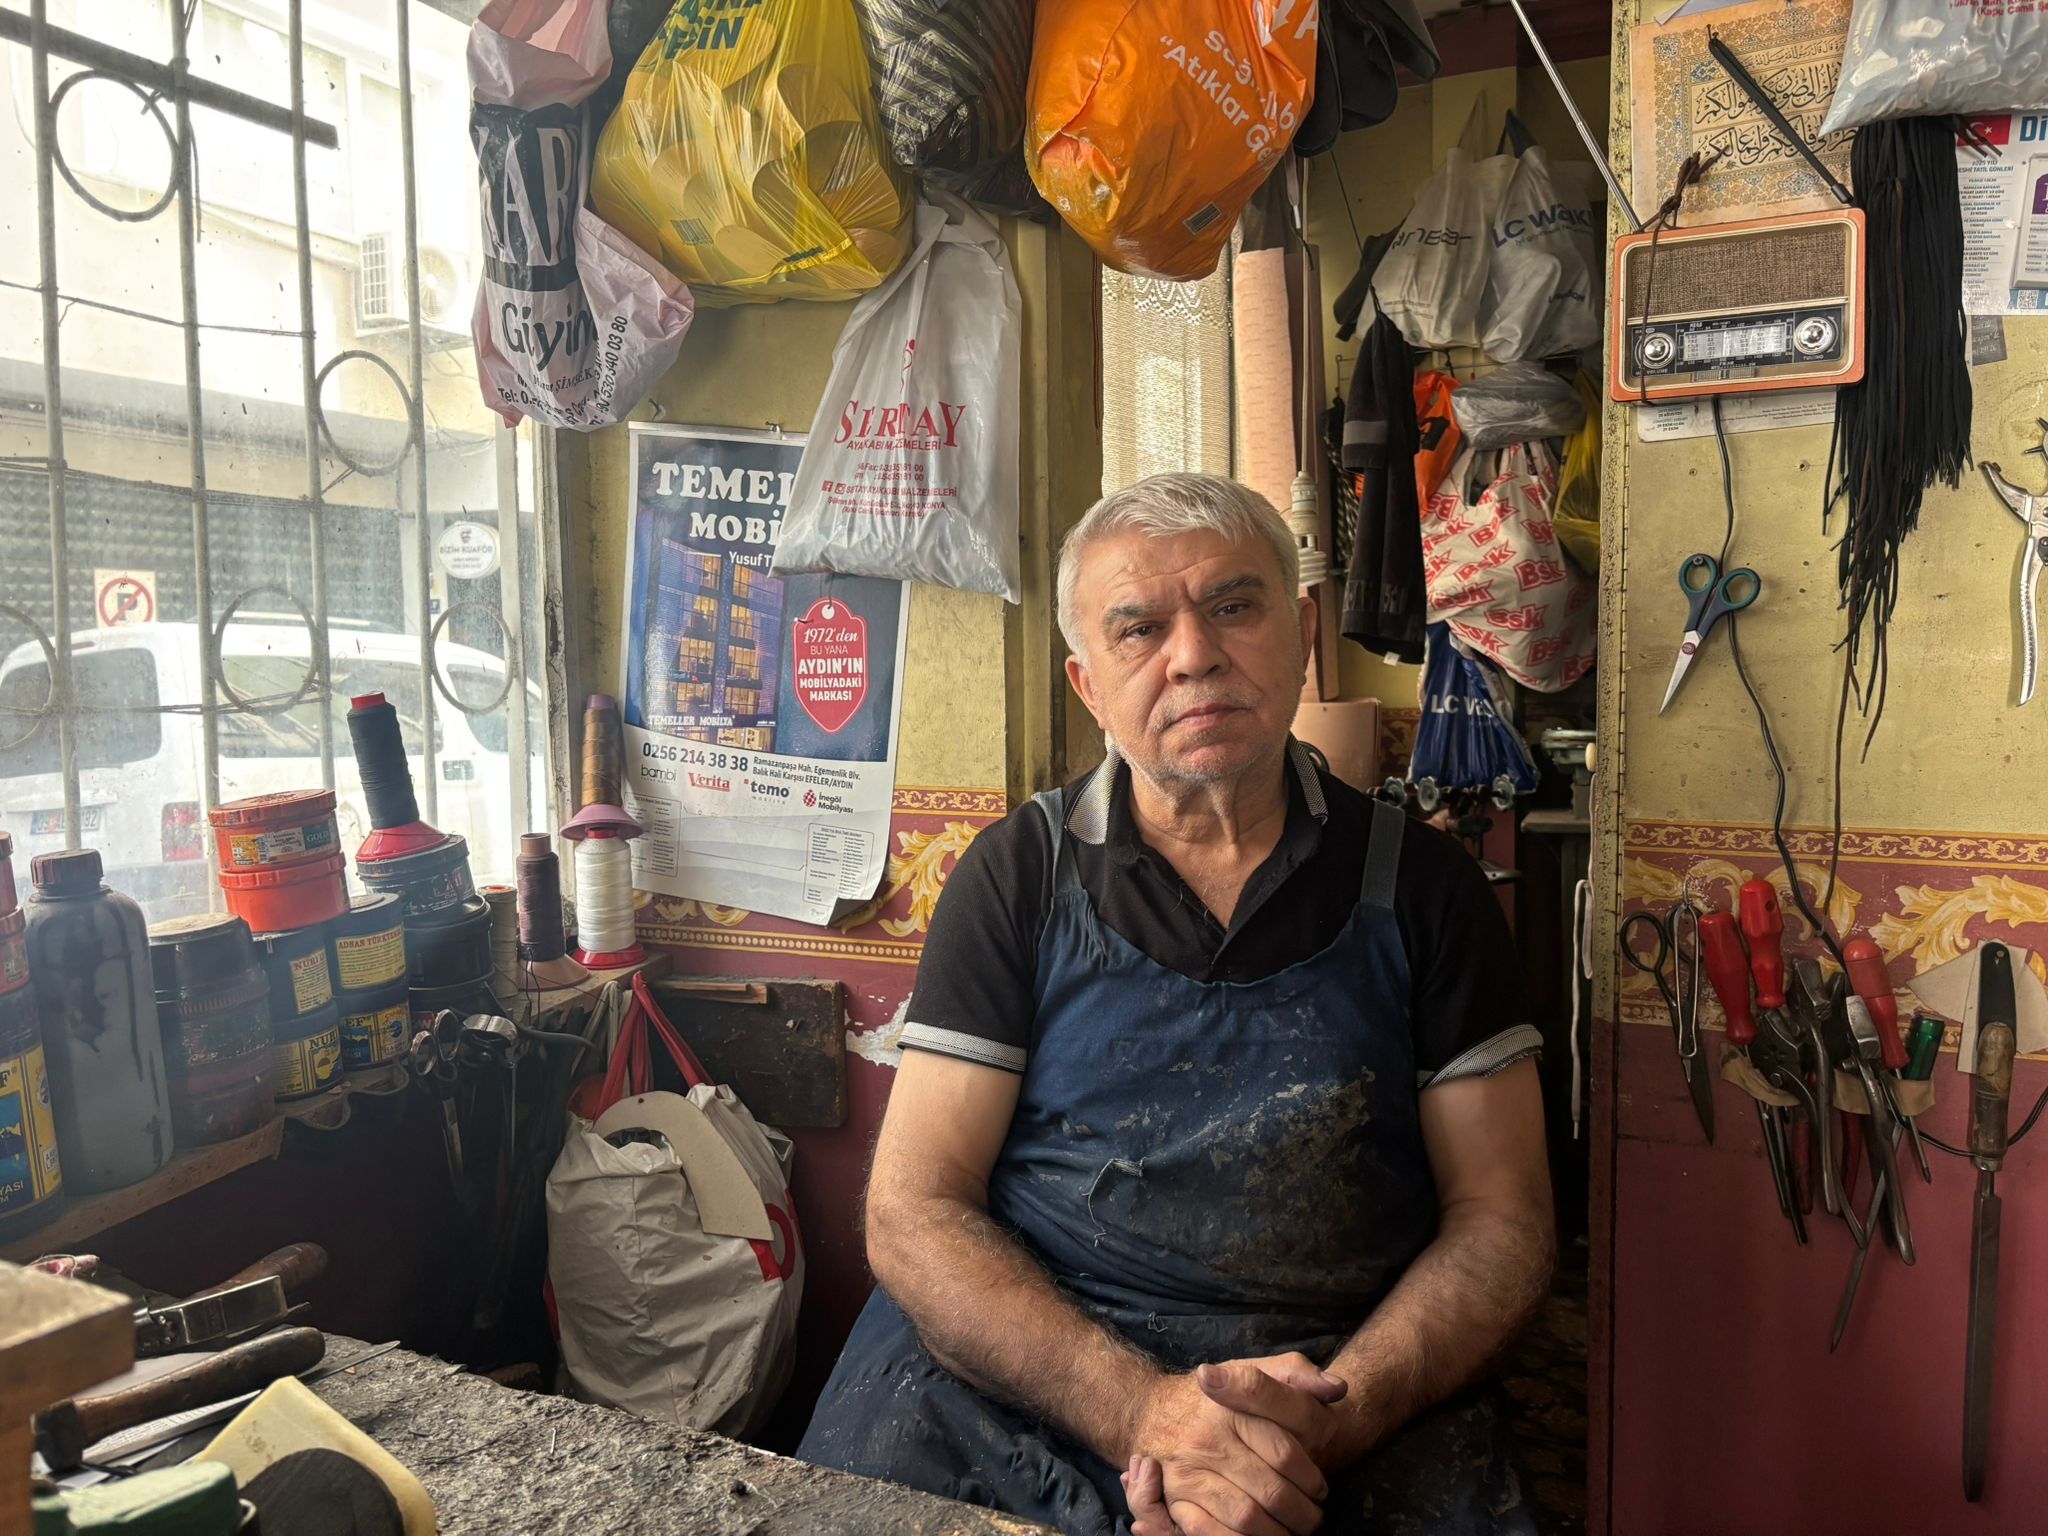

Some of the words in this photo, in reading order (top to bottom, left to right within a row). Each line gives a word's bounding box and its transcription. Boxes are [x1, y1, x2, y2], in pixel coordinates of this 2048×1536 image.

[1492, 219, 1526, 248] LC
[729, 551, 763, 566] Yusuf
[810, 646, 822, 655] BU
[824, 645, 848, 655] YANA
[798, 657, 863, 674] AYDIN'IN
[800, 674, 862, 689] MOBİLYADAKİ
[810, 690, 852, 701] MARKASI
[648, 714, 695, 726] TEMELLER
[643, 742, 677, 761] 0256
[680, 748, 705, 766] 214
[708, 752, 727, 769] 38
[730, 755, 748, 772] 38
[641, 764, 677, 781] bambi
[753, 756, 797, 771] Ramazanpaşa
[798, 764, 813, 773] Mah.
[814, 766, 847, 778] Egemenlik
[848, 771, 861, 781] Blv.
[688, 772, 730, 790] Verita
[805, 775, 853, 790] EFELER/AYDIN
[750, 780, 789, 798] temo
[818, 792, 842, 804] İnegöl
[818, 802, 854, 814] Mobilyası
[306, 830, 329, 842] GOLD
